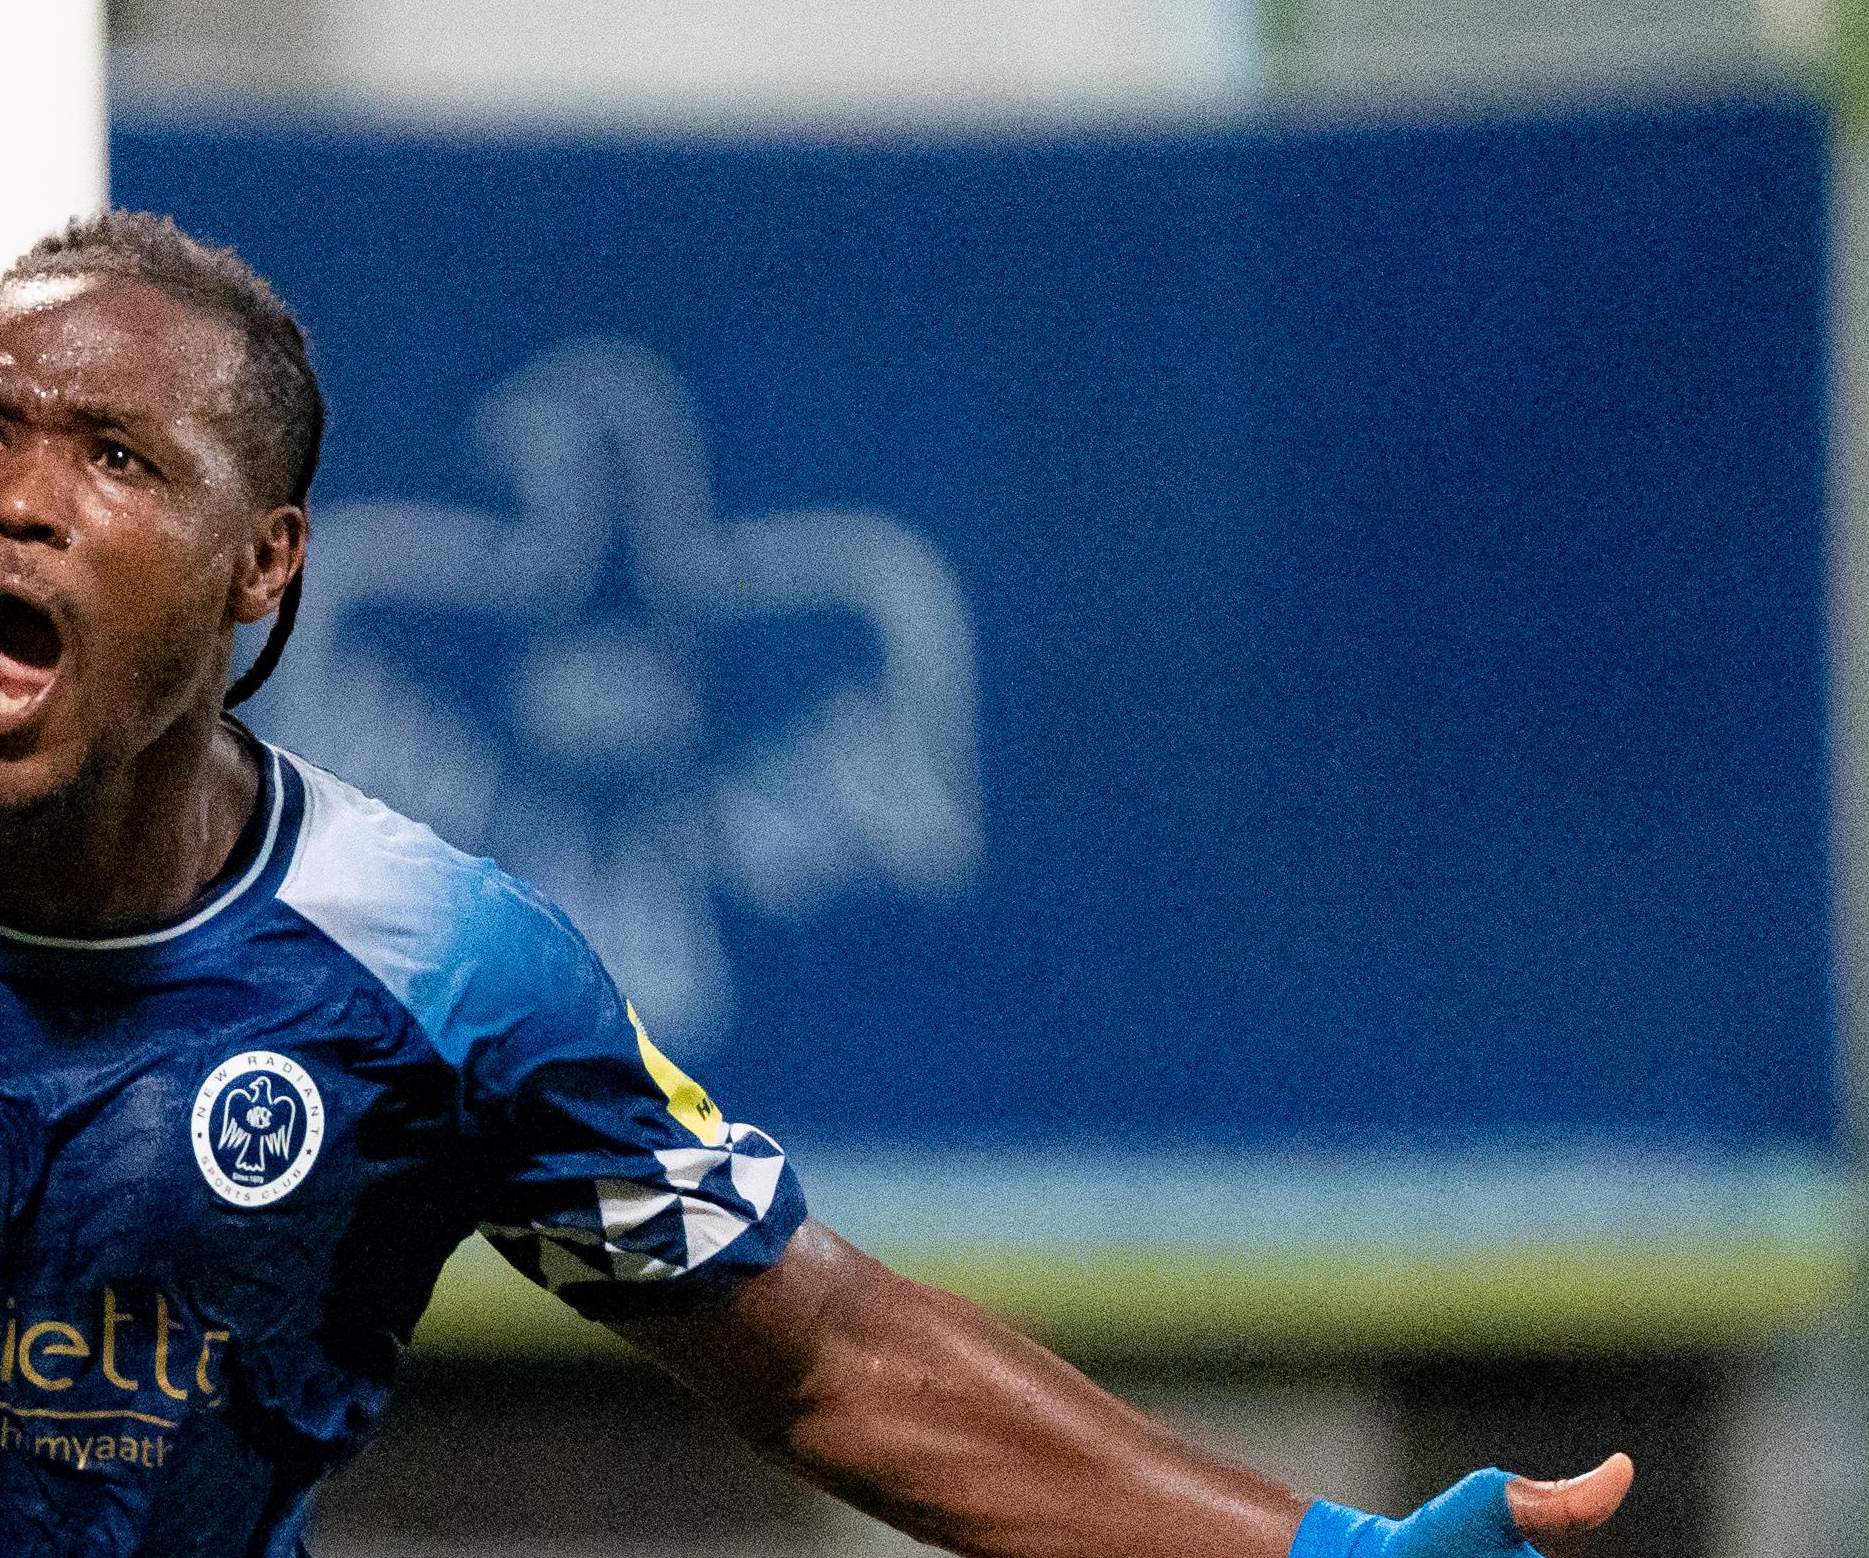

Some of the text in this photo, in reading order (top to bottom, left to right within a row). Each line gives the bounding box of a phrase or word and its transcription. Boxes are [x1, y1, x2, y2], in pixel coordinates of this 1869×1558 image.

[196, 1055, 321, 1135] NEW RADIANT
[200, 1155, 302, 1202] SPORTS CLUB
